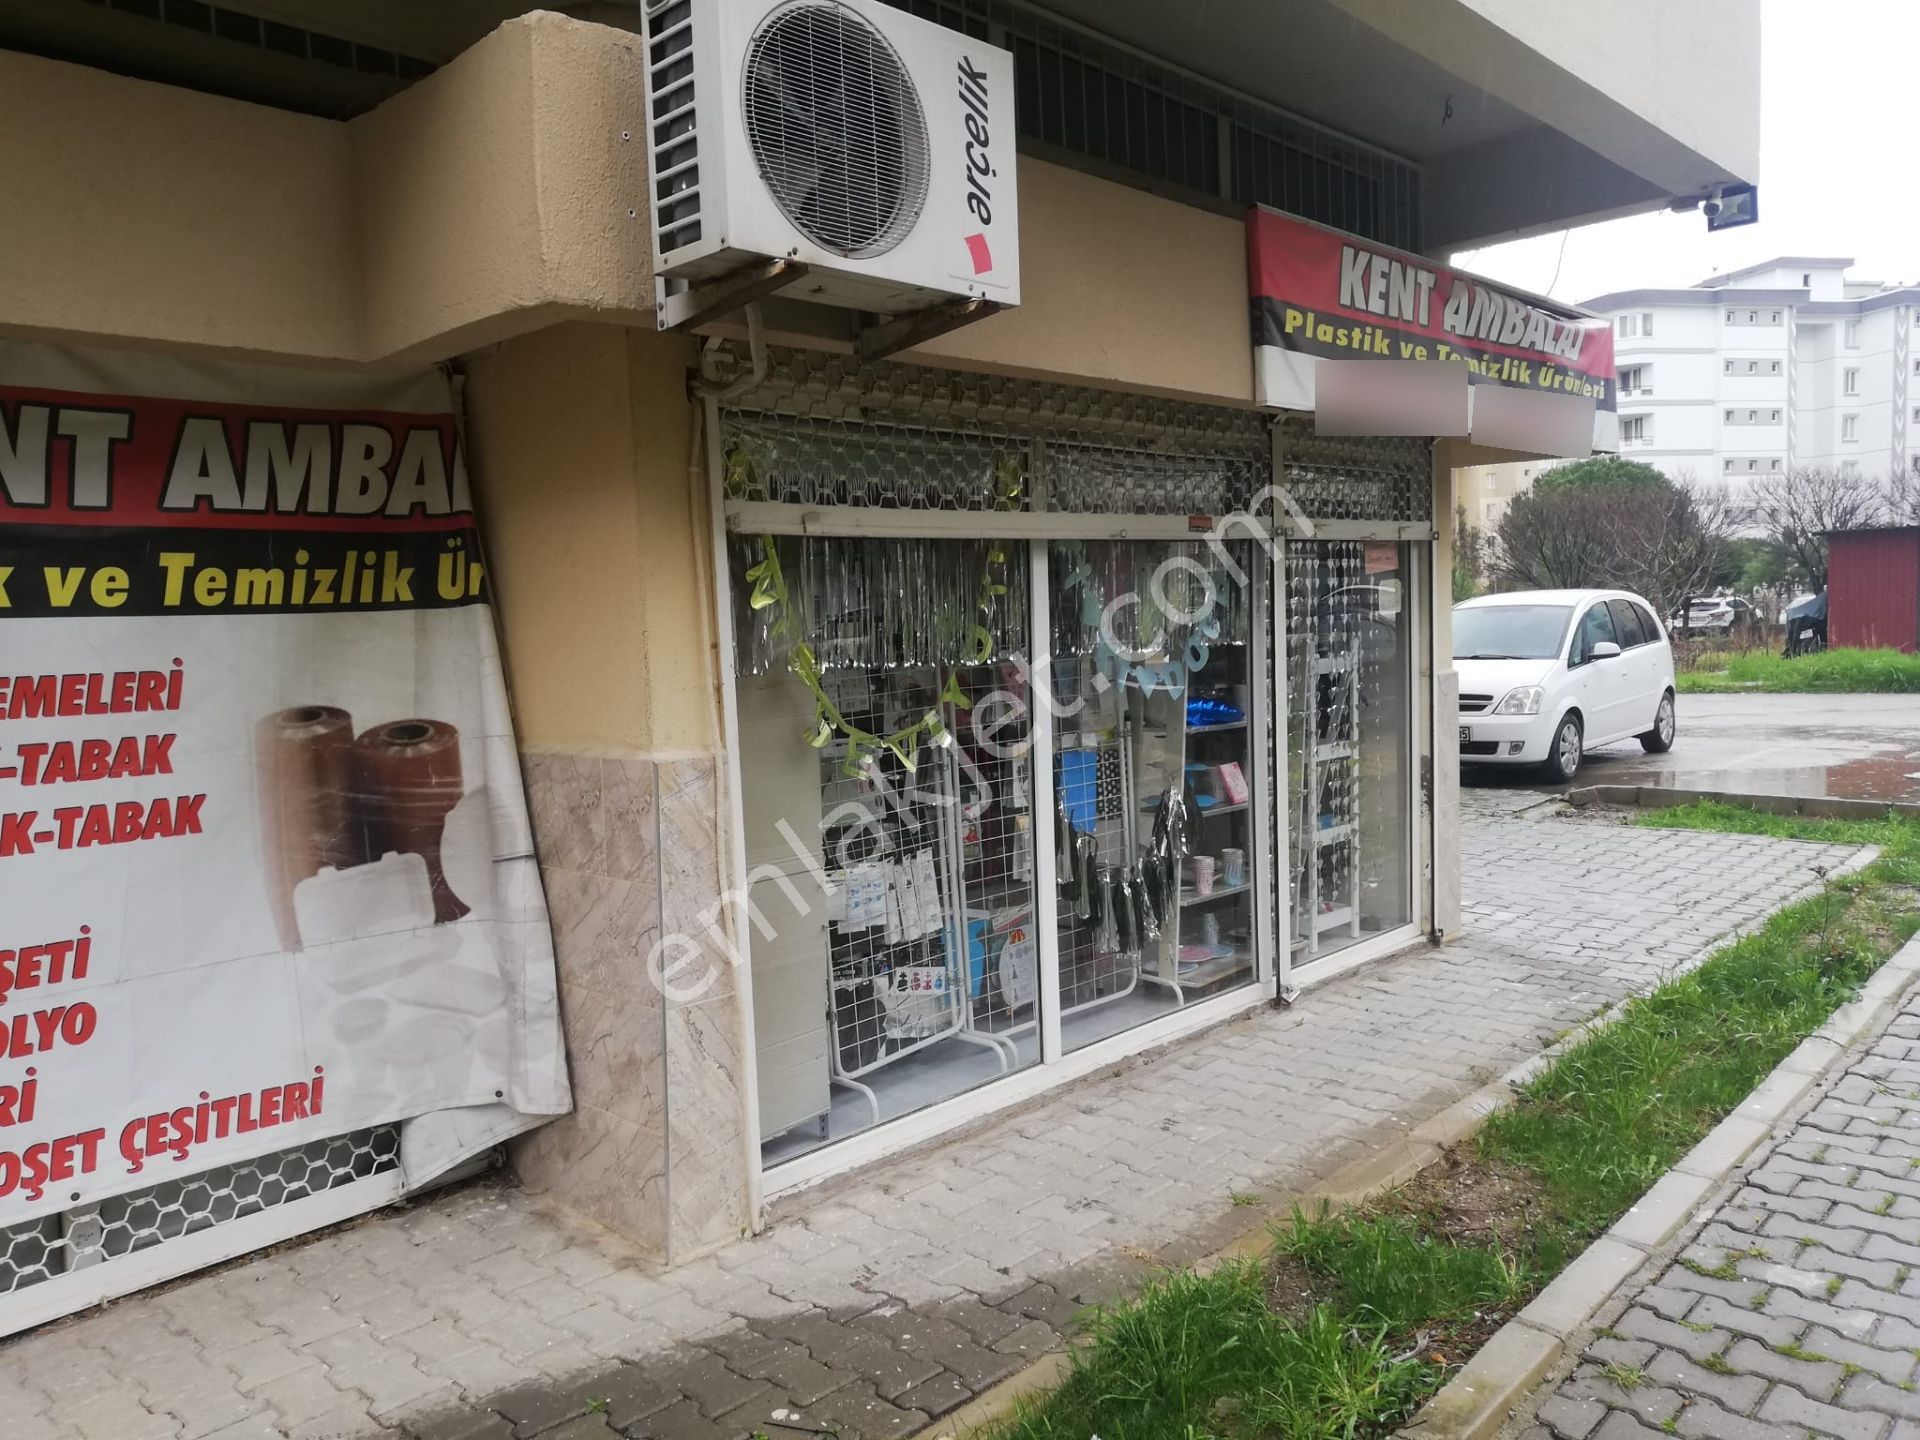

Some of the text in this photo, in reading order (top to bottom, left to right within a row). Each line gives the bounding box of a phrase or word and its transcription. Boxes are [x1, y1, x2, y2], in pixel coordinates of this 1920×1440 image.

[957, 55, 997, 226] arçelik
[1284, 308, 1391, 356] Plastik
[1399, 341, 1428, 360] ve
[1539, 362, 1605, 399] Ürünleri
[1339, 245, 1586, 361] KENT AMBALAJ
[43, 566, 130, 608] ve
[159, 548, 415, 607] Temizlik
[119, 1065, 325, 1174] ÇEŞİTLERİ
